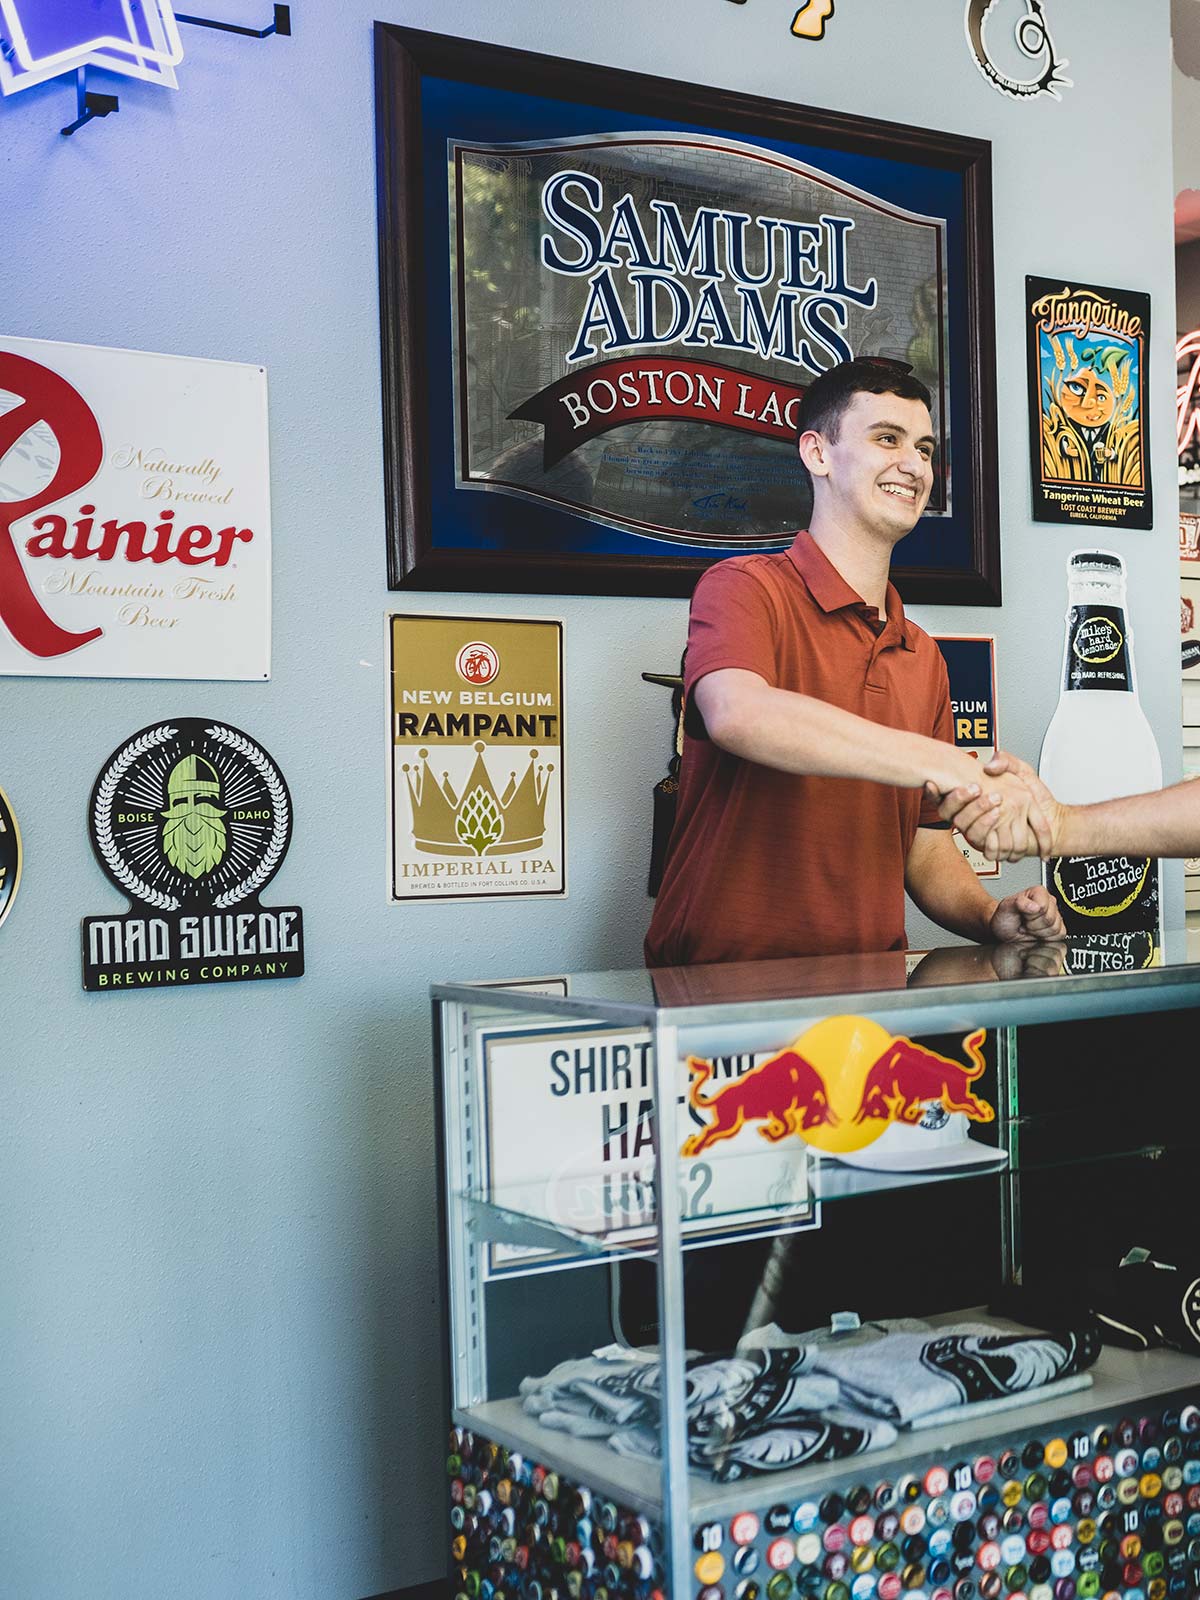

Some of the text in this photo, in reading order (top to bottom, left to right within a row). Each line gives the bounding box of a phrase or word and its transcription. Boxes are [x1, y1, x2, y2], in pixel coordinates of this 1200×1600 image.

[541, 170, 878, 310] SAMUEL
[566, 267, 855, 376] ADAMS
[1032, 287, 1145, 340] Tangerine
[559, 370, 725, 429] BOSTON
[111, 446, 223, 485] Naturally
[142, 478, 234, 504] Brewed
[1043, 489, 1144, 508] Tangerine Wheat Beer
[1077, 505, 1096, 513] COAST
[1097, 506, 1126, 515] BREWERY
[43, 569, 237, 602] Mountain Fresh
[118, 602, 181, 629] Beer
[1081, 624, 1112, 639] mike's
[1089, 634, 1112, 646] hard
[1081, 641, 1118, 656] lemonade
[402, 690, 553, 707] NEW BELGIUM
[398, 711, 557, 738] RAMPANT
[957, 719, 988, 739] RE
[118, 810, 271, 823] BOISE IDAHO
[402, 859, 556, 878] IMPERIAL IPA
[1069, 866, 1143, 902] lemonade
[89, 911, 299, 965] MAD SWEDE
[99, 962, 289, 986] BREWING COMPANY
[550, 1041, 756, 1098] SHIRT ND
[1073, 1436, 1089, 1459] 10
[954, 1465, 972, 1491] 10
[1124, 1510, 1139, 1532] 10
[701, 1523, 722, 1552] 10
